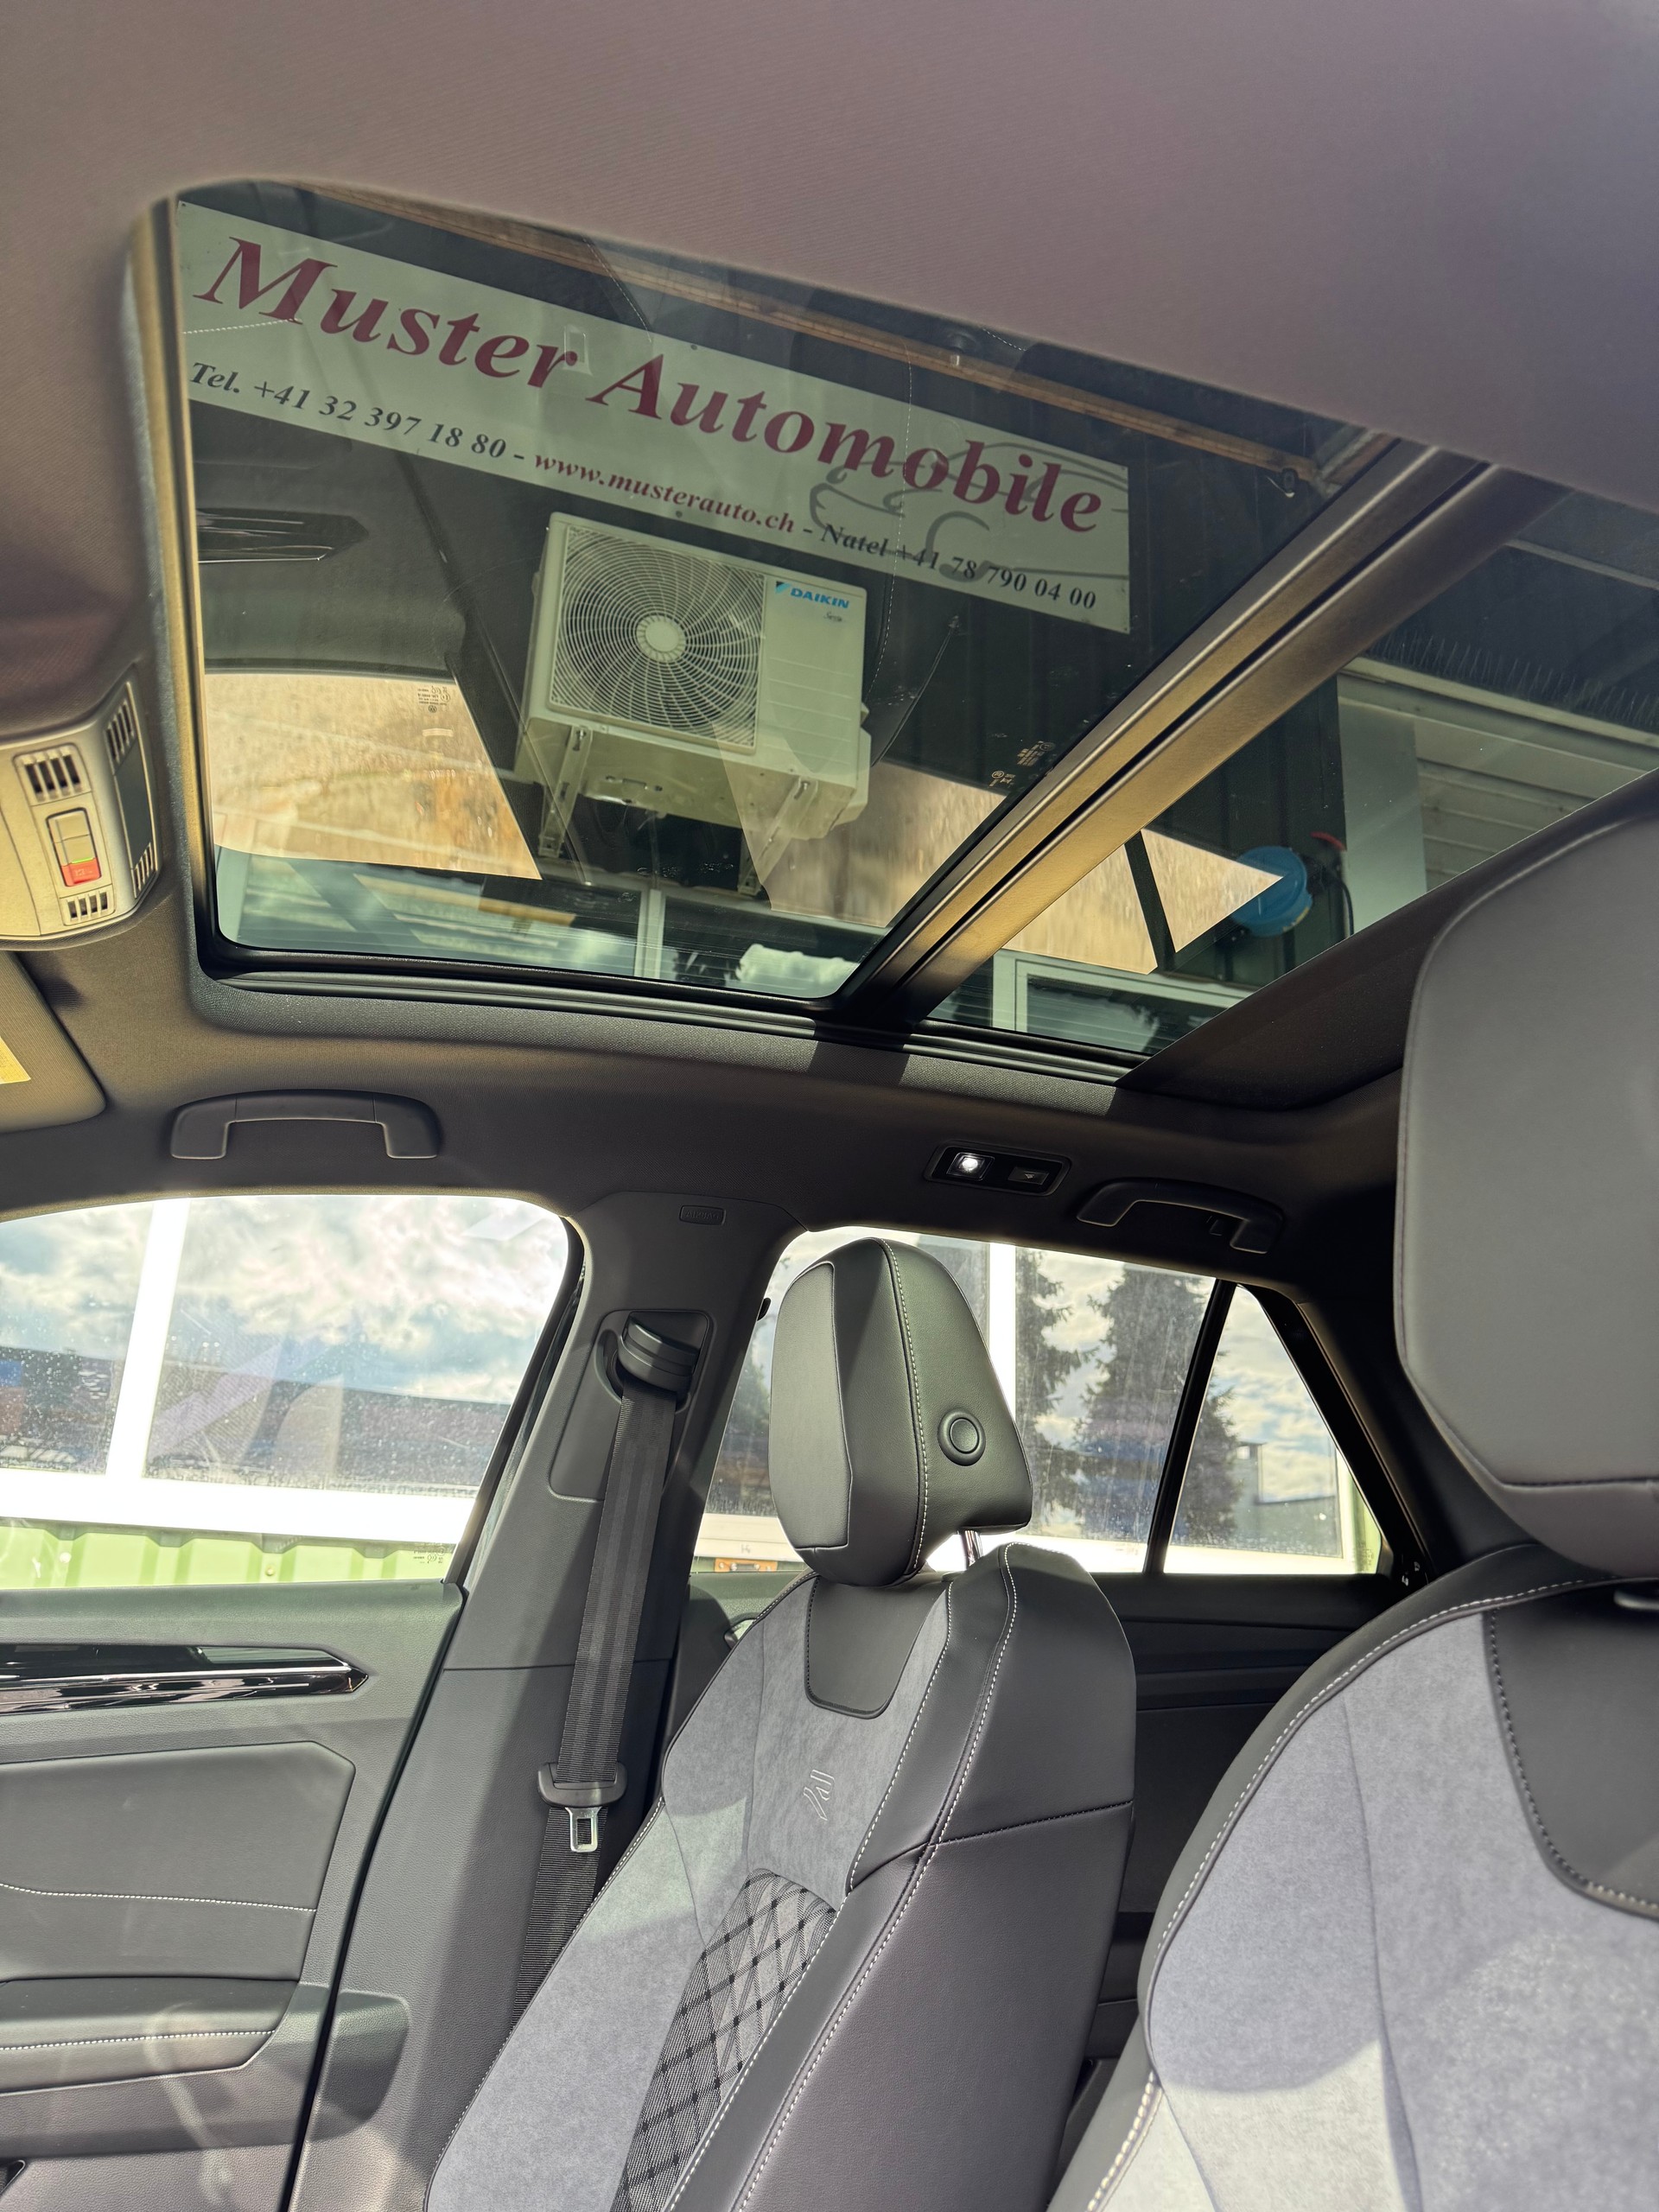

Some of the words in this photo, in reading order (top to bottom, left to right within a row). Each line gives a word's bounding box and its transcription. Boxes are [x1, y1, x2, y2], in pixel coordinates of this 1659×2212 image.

[190, 362, 240, 394] Tel.
[254, 381, 310, 410] +41
[319, 396, 357, 421] 32
[364, 407, 422, 435] 397
[429, 423, 463, 448] 18
[471, 434, 506, 458] 80
[534, 454, 796, 532] www.musterauto.ch
[821, 523, 889, 557] Natel
[897, 544, 939, 569] +41
[952, 556, 977, 580] 78
[988, 566, 1027, 592] 790
[1035, 578, 1062, 601] 04
[1069, 587, 1096, 609] 00
[193, 236, 578, 388] Muster
[586, 353, 1102, 532] Automobile
[791, 588, 849, 608] DAIKIN
